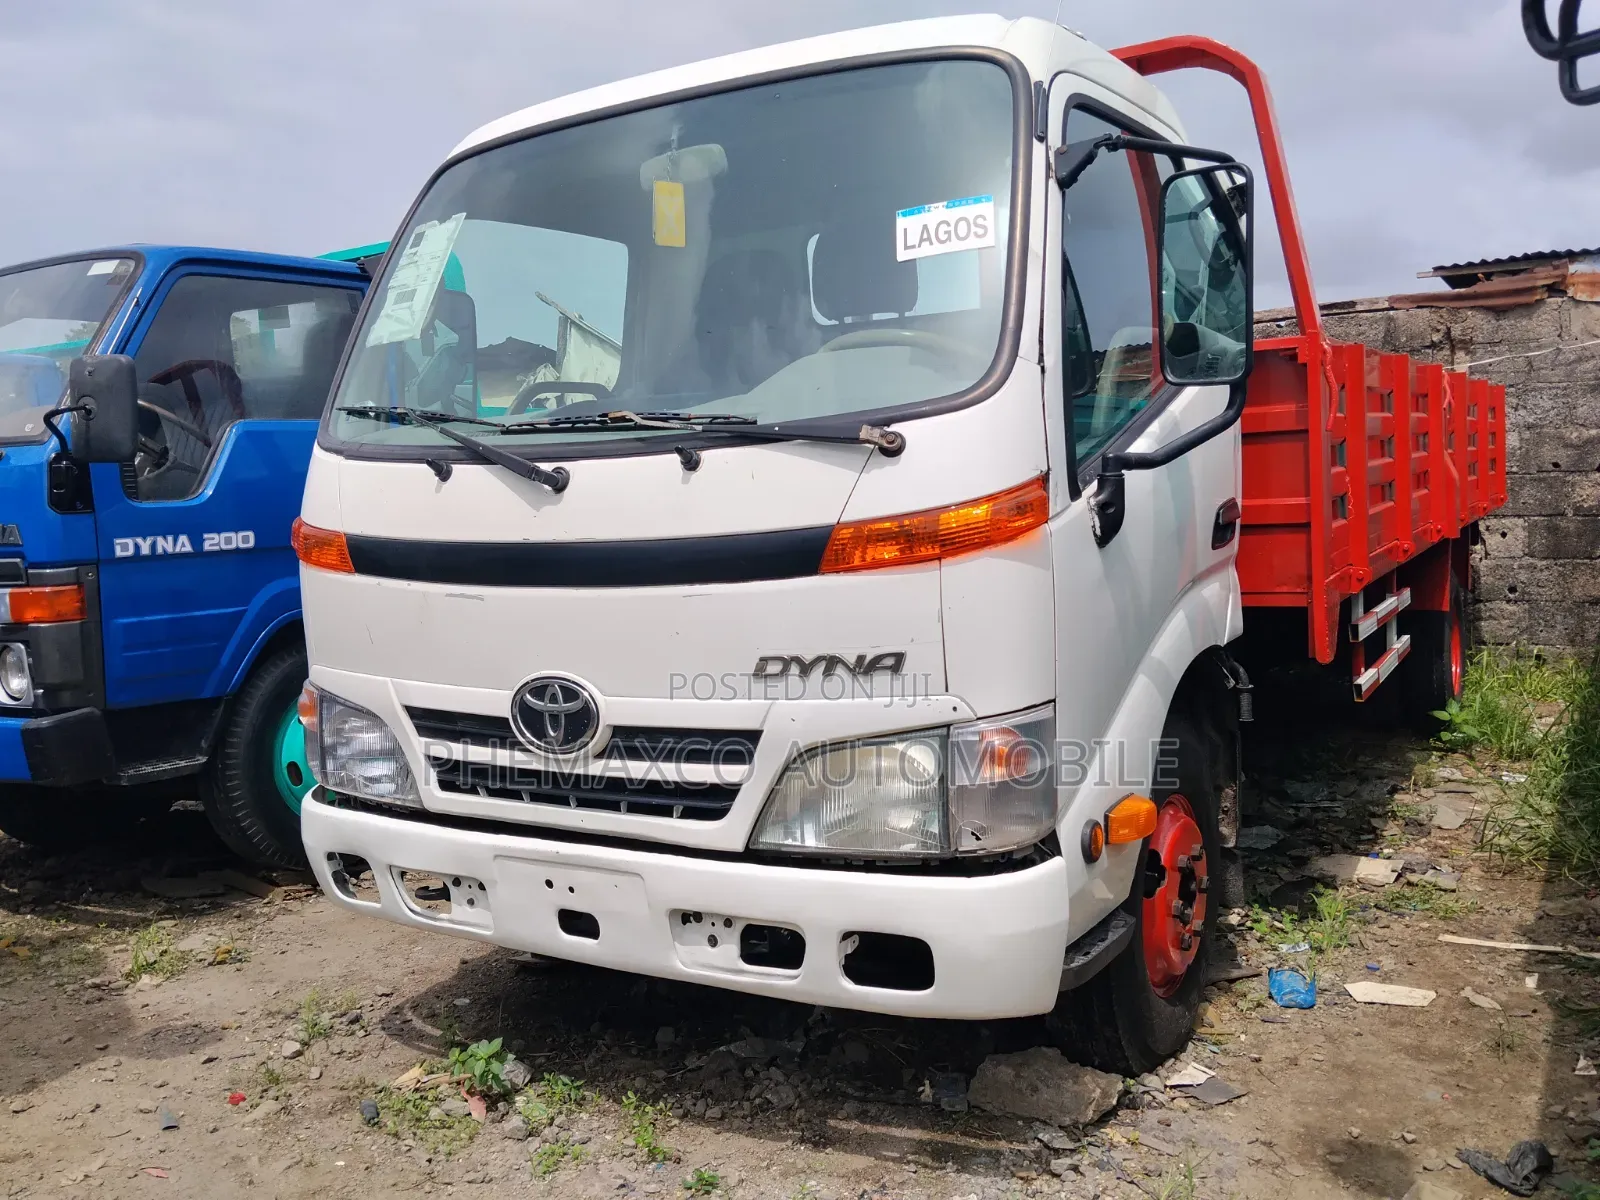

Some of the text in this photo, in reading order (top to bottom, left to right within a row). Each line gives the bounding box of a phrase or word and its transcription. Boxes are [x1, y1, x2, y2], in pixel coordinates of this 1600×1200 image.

[903, 214, 989, 251] LAGOS
[114, 531, 255, 558] DYNA 200
[752, 651, 906, 678] DYNA
